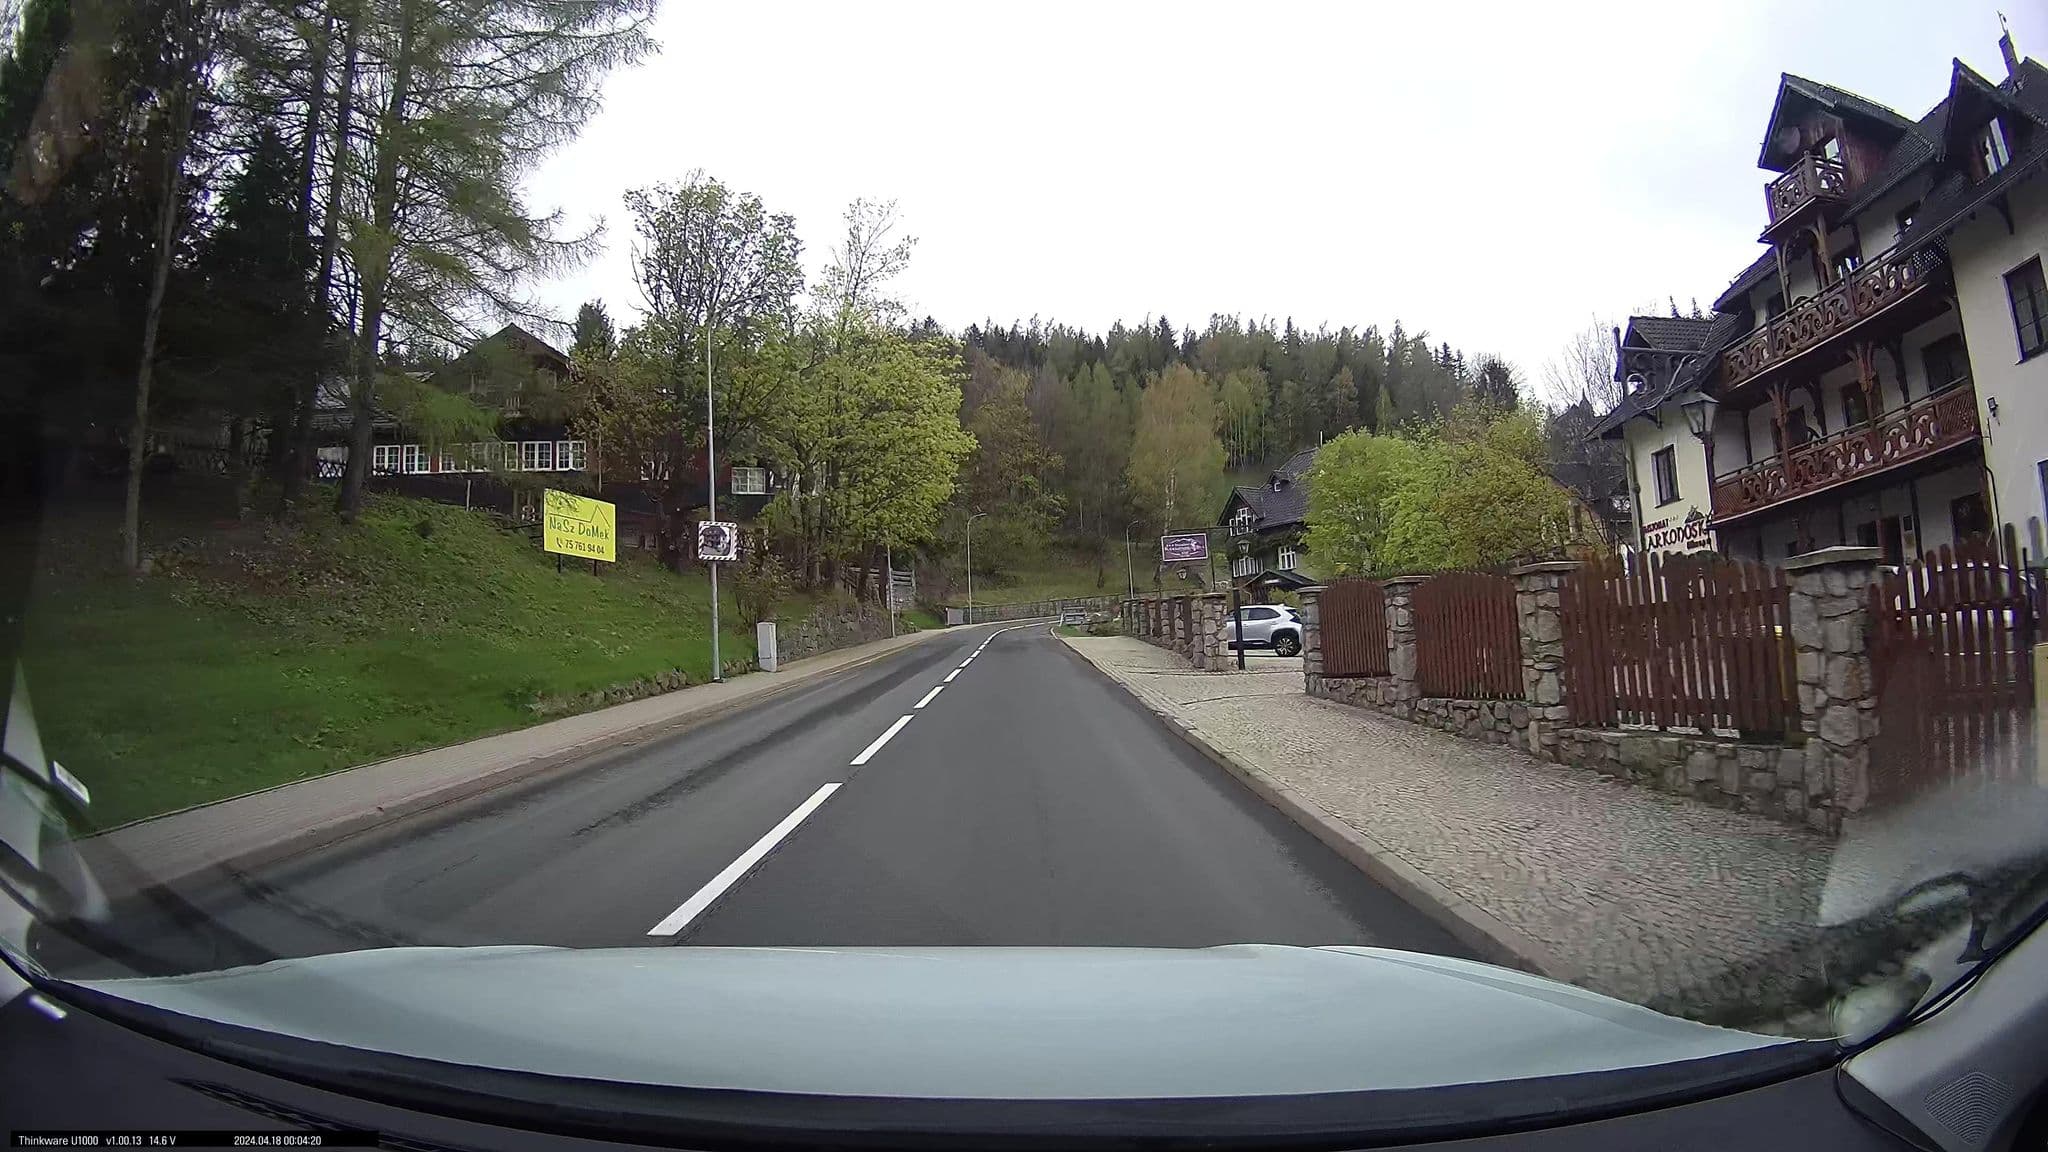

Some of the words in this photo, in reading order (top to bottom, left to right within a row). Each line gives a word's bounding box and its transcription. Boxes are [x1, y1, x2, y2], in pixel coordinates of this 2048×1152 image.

[565, 539, 574, 550] 75
[575, 541, 586, 552] 761
[587, 543, 596, 553] 94
[596, 545, 605, 555] 04
